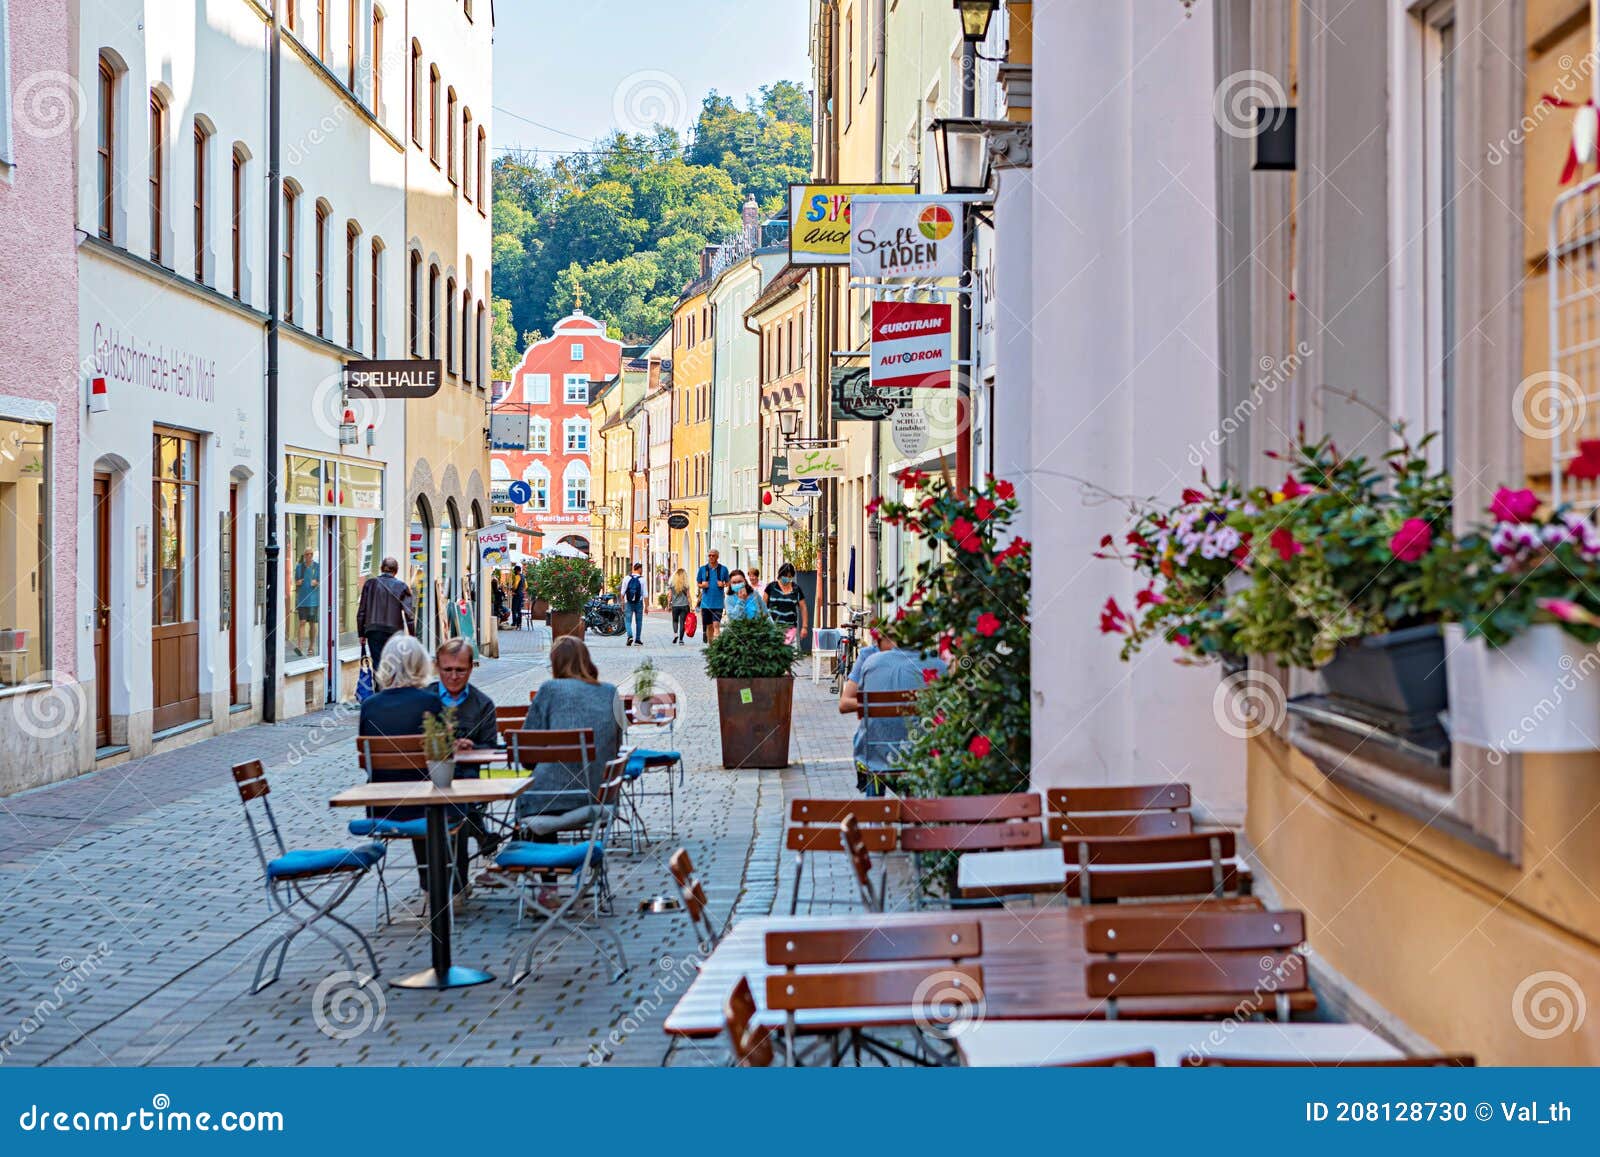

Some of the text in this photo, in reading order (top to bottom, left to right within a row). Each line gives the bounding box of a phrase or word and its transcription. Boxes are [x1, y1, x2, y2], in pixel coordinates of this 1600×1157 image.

[858, 228, 917, 254] Saft
[880, 242, 937, 269] LADEN
[879, 317, 943, 335] EUROTRAIN
[93, 322, 216, 403] Goldschmiede Heidi Wolf
[880, 349, 942, 366] AUTODROM
[351, 371, 436, 387] SPIELHALLE
